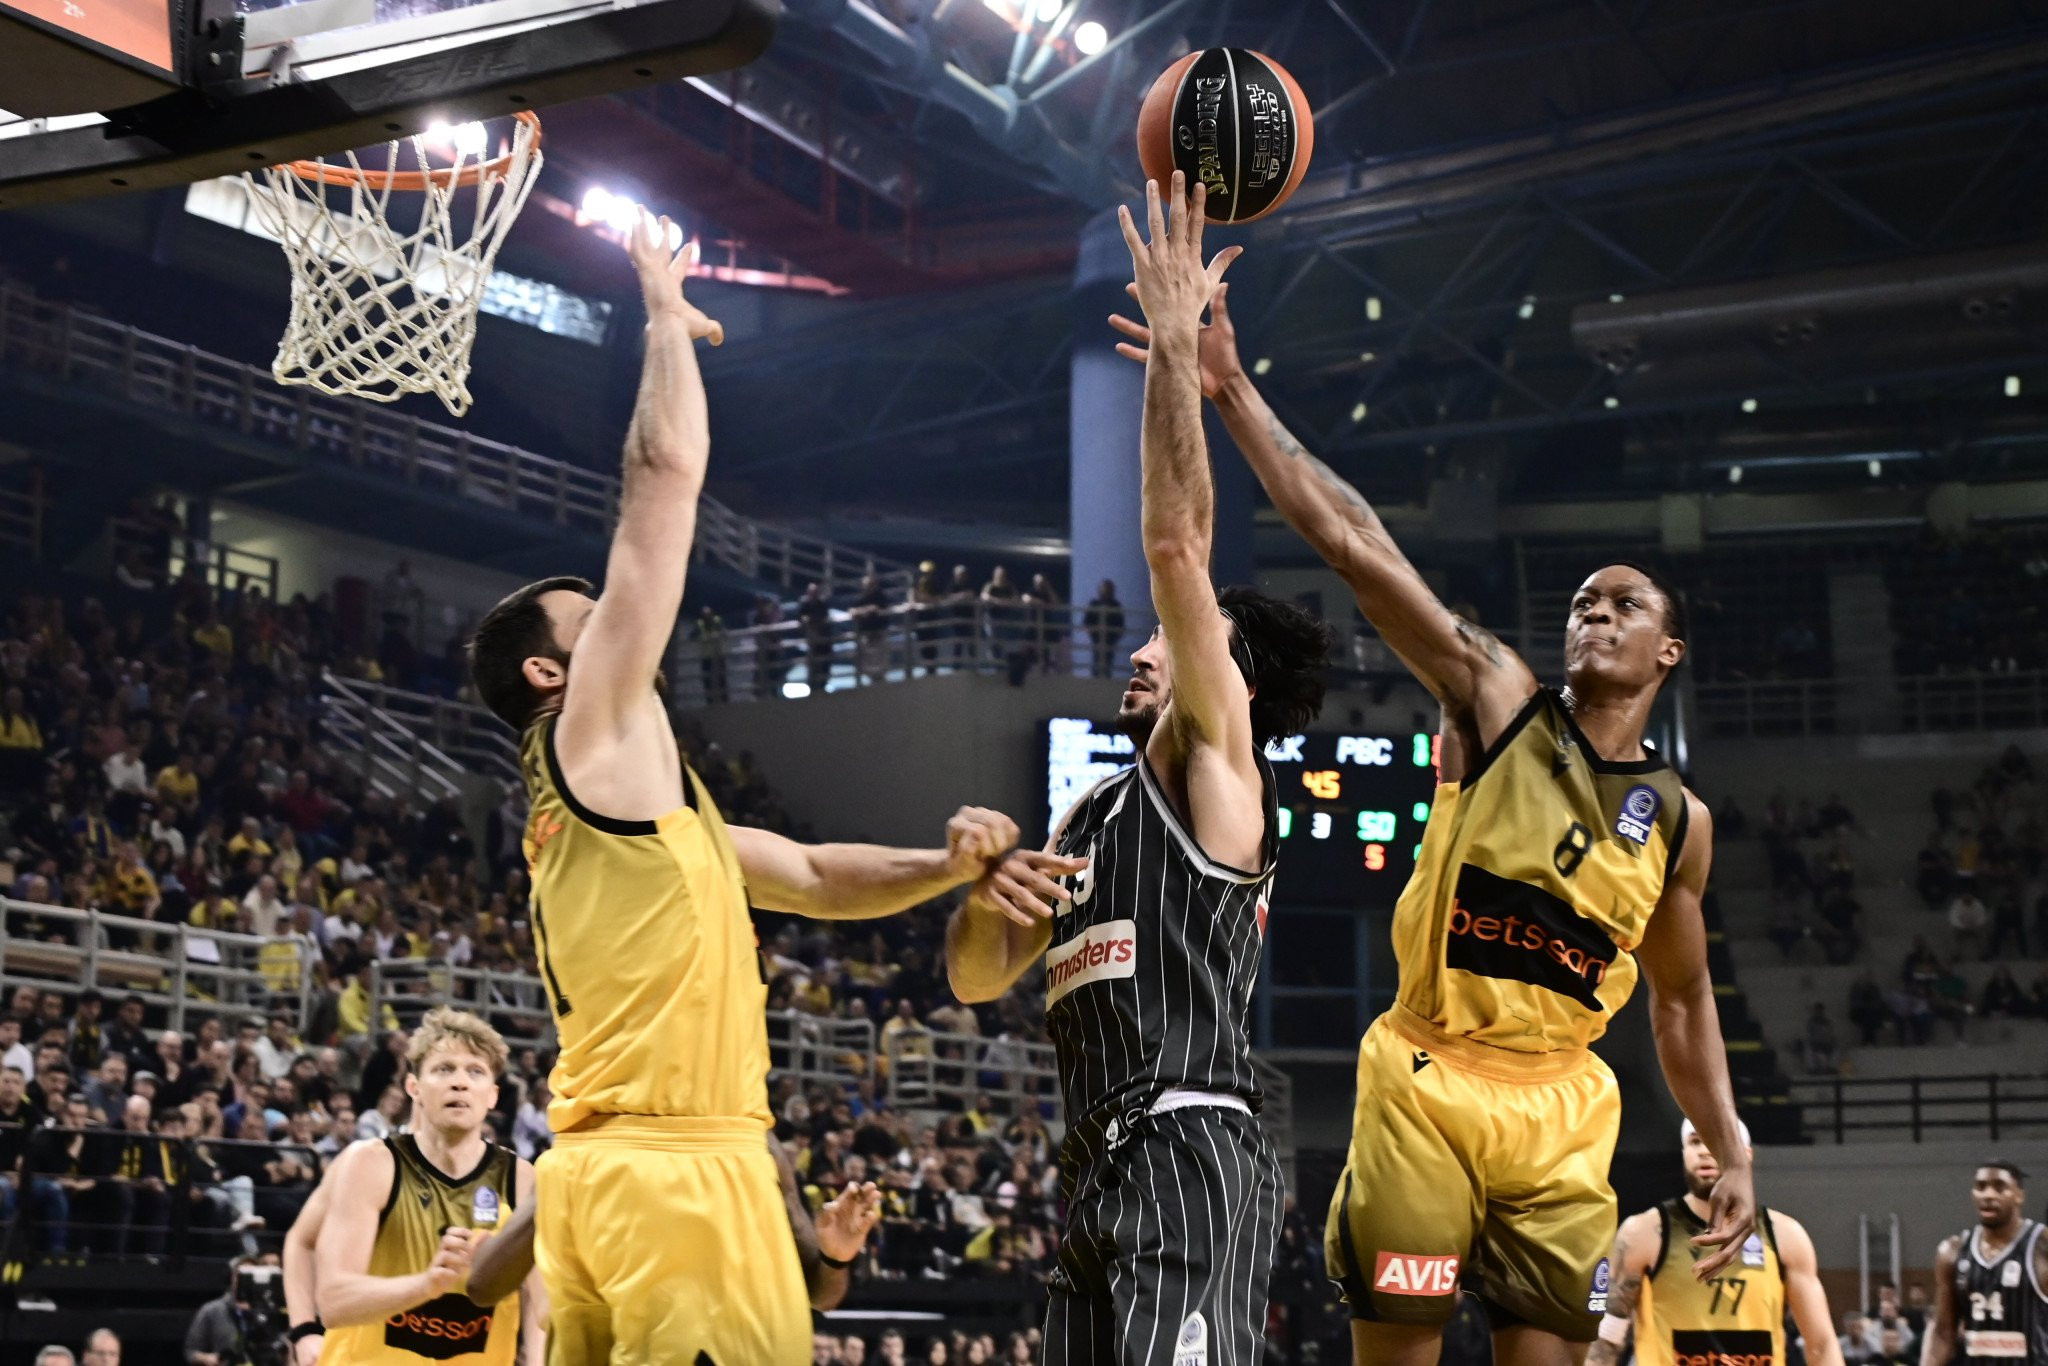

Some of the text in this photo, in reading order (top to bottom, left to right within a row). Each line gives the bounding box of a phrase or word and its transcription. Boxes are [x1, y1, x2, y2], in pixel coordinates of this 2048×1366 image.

[1196, 74, 1229, 195] SPALDING
[1246, 83, 1270, 188] LEGACY
[1336, 736, 1393, 766] PBC
[1303, 770, 1340, 799] 45
[1357, 811, 1396, 841] 50
[1365, 844, 1385, 870] 5
[1553, 820, 1593, 878] 8
[1449, 897, 1606, 984] betsson
[1375, 1257, 1459, 1292] AVIS
[1707, 1277, 1747, 1316] 77
